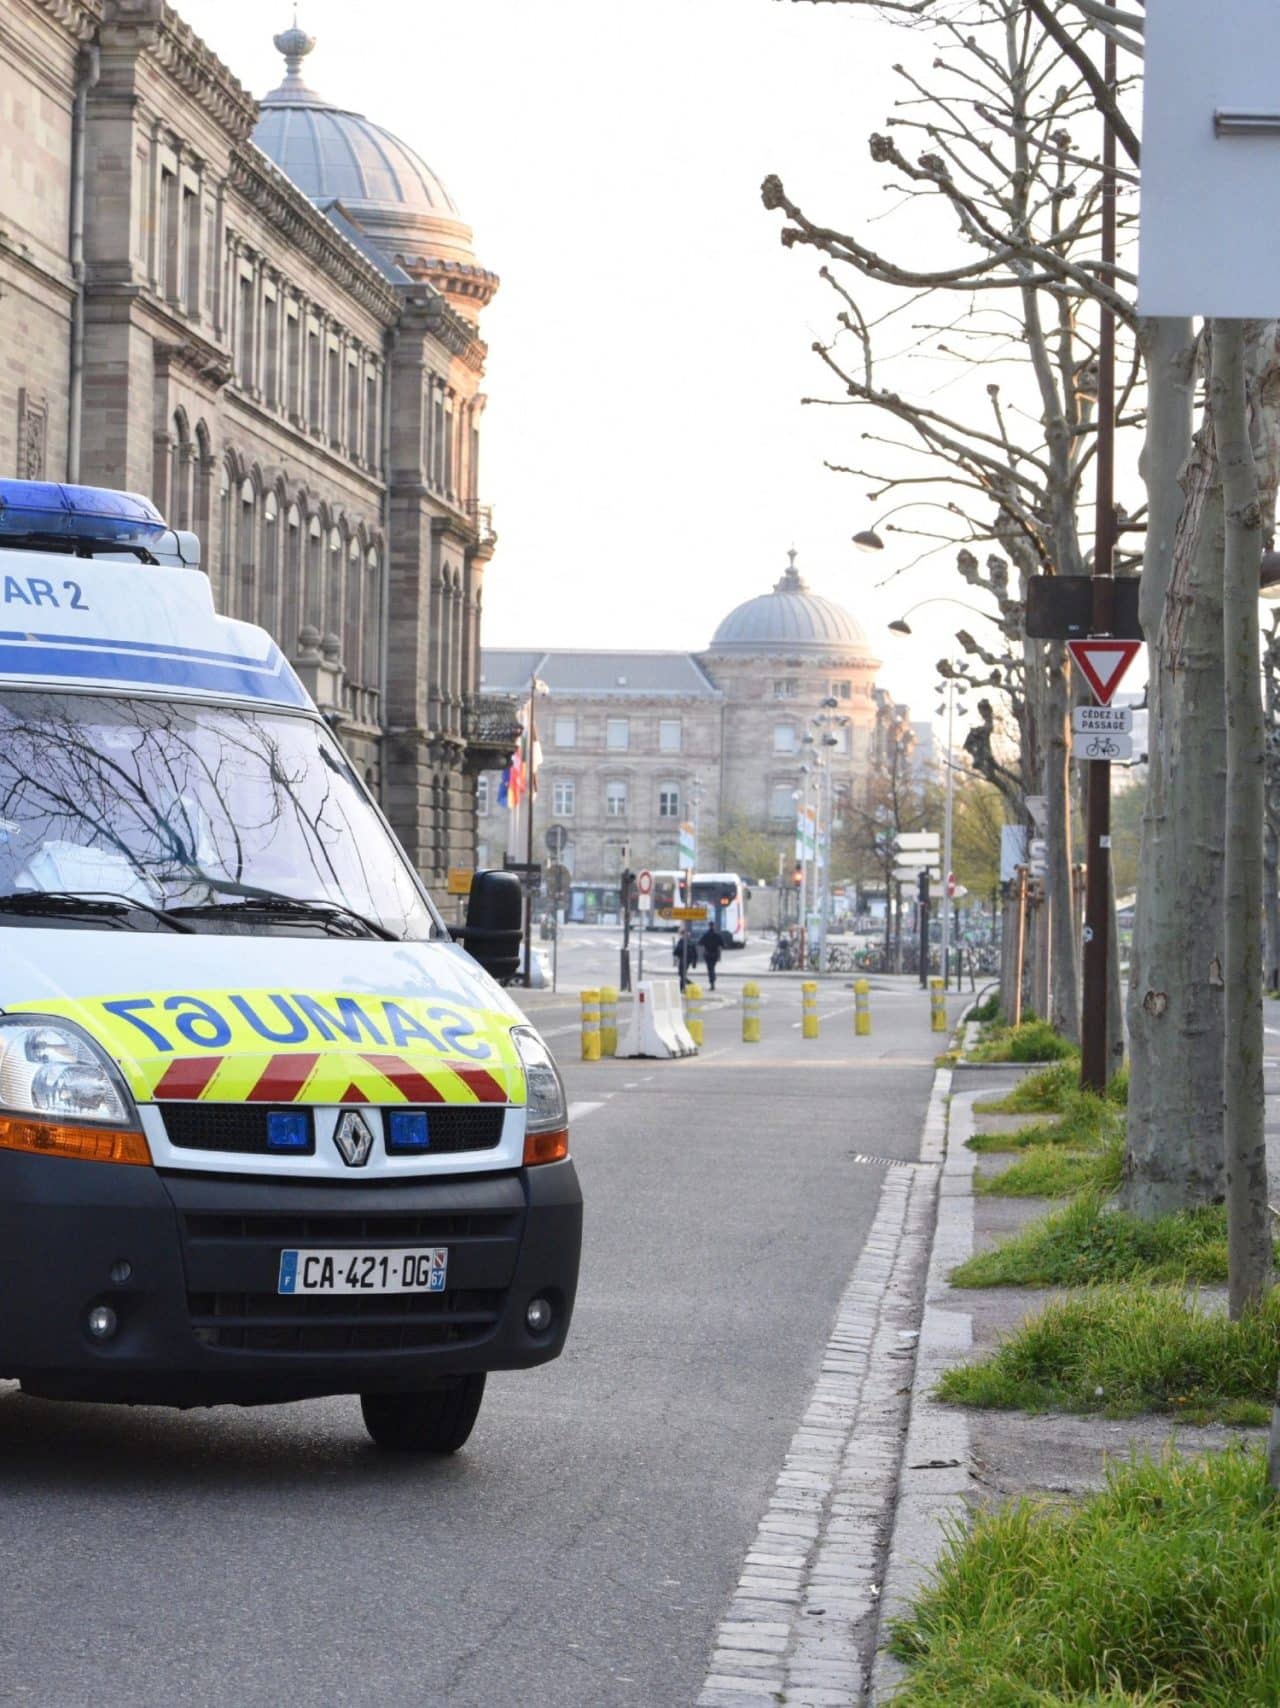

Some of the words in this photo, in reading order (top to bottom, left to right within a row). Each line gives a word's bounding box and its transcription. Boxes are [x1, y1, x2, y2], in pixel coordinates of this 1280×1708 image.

[1081, 709, 1112, 720] CÉDEZ
[1114, 710, 1126, 720] LE
[1081, 720, 1125, 730] PASSAGE
[285, 1276, 291, 1286] F
[431, 1271, 444, 1286] 67
